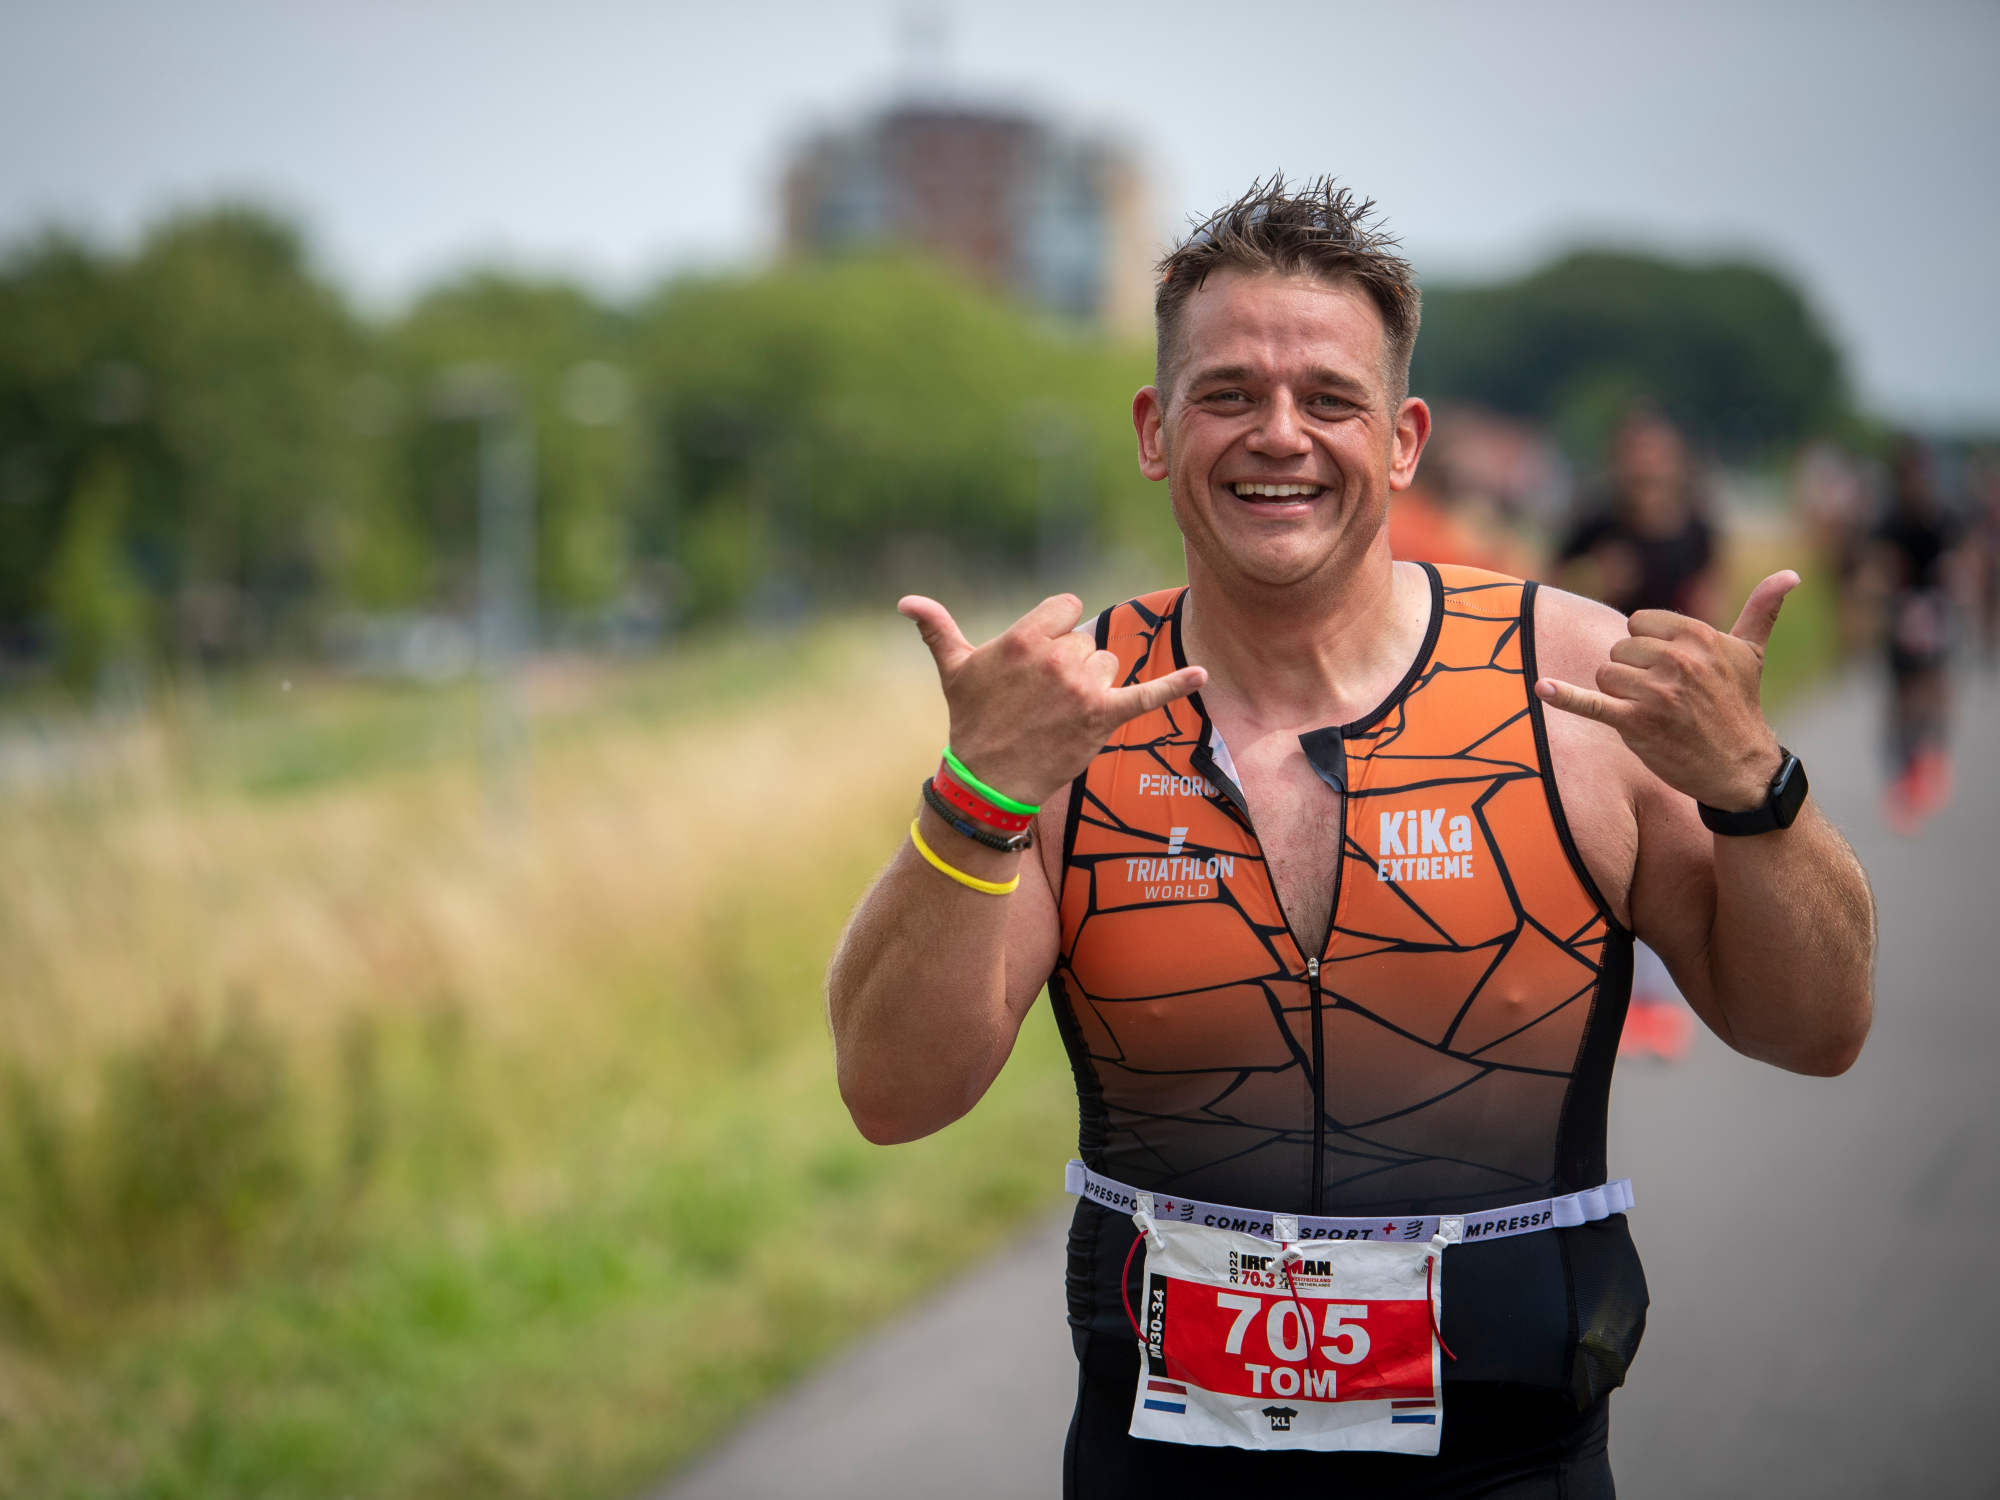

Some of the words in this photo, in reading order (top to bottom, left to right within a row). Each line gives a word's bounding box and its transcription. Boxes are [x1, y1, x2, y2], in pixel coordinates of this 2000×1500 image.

[1139, 774, 1219, 796] PERFORM
[1380, 808, 1473, 856] KiKa
[1126, 856, 1234, 882] TRIATHLON
[1377, 854, 1474, 882] EXTREME
[1144, 884, 1209, 899] WORLD
[1204, 1215, 1373, 1240] COMPRSPORT
[1229, 1251, 1238, 1284] 2022
[1241, 1254, 1332, 1276] IROMAN
[1241, 1270, 1275, 1288] 70.3
[1149, 1289, 1165, 1359] M30-34
[1217, 1292, 1370, 1365] 705
[1245, 1363, 1337, 1398] TOM
[1272, 1416, 1290, 1427] XL
